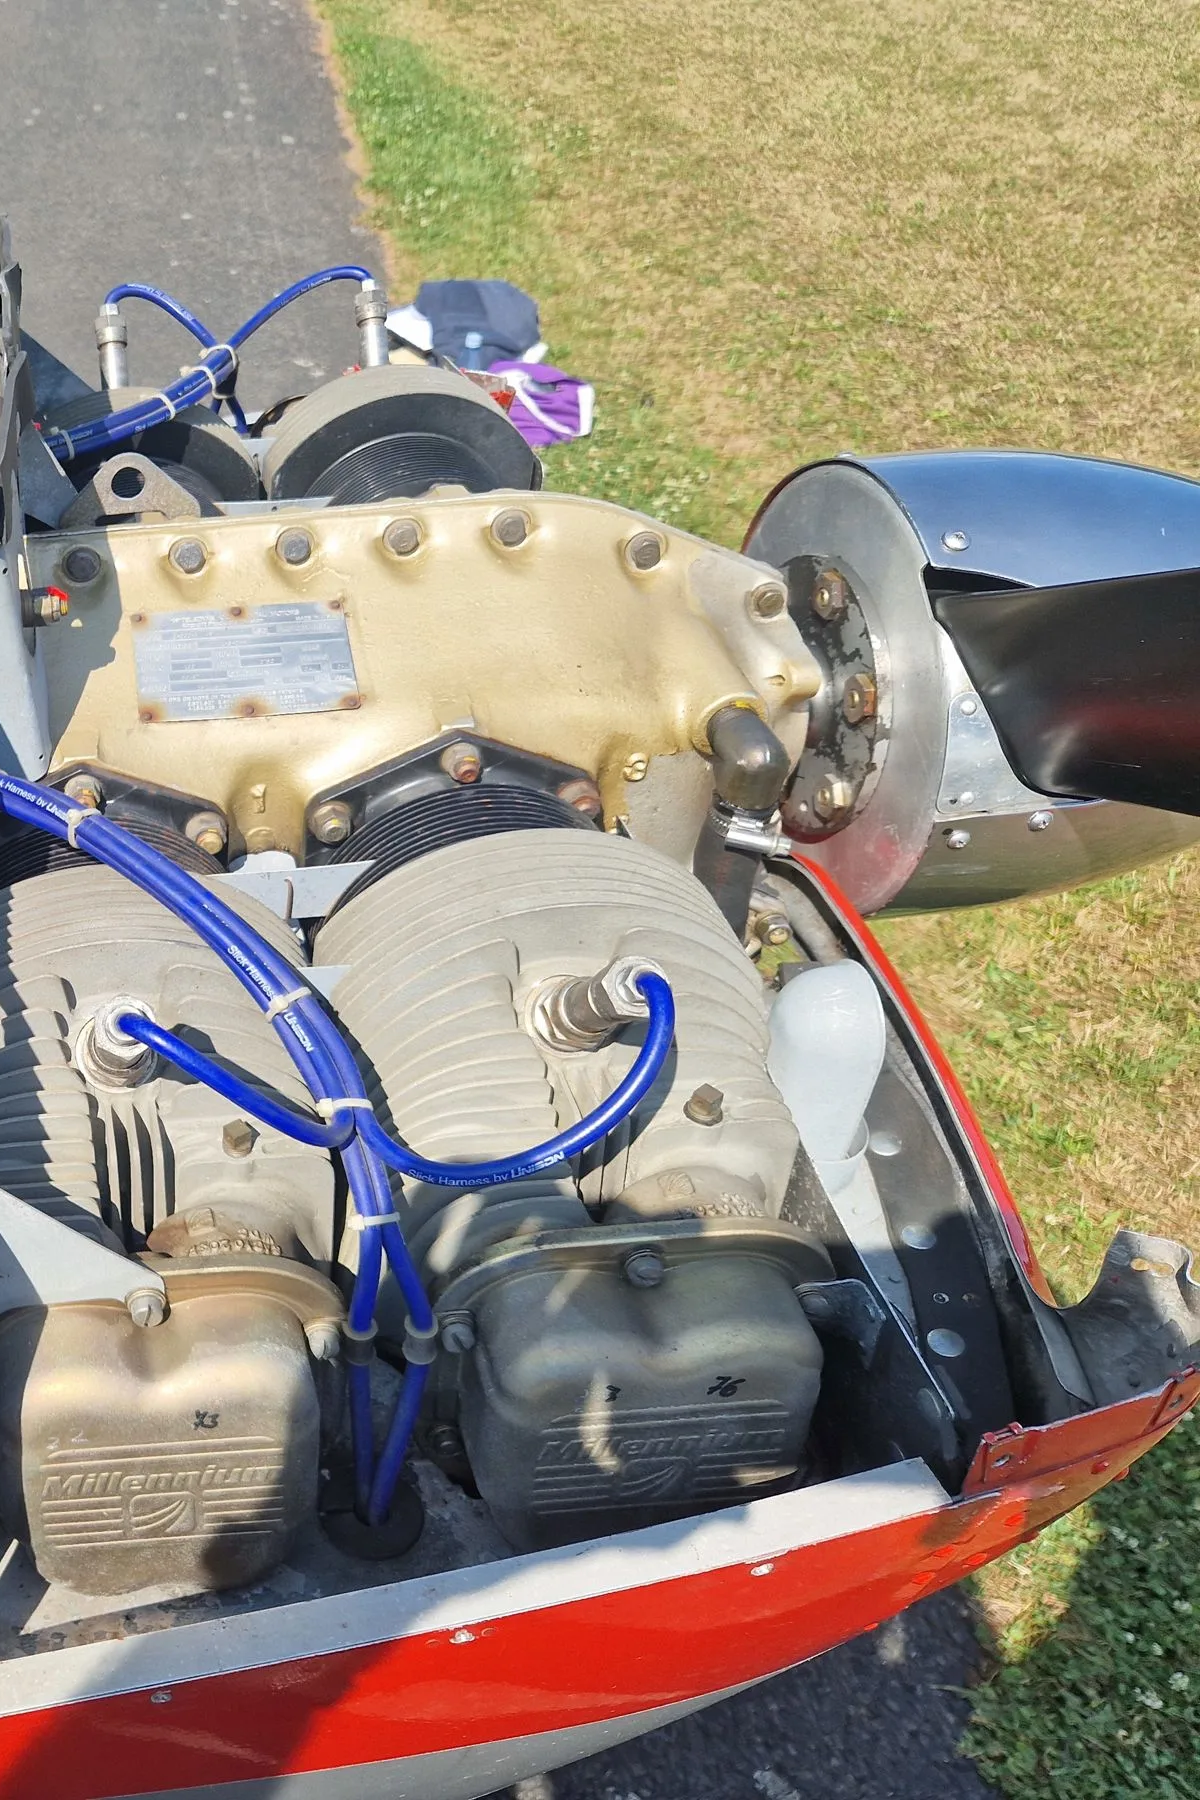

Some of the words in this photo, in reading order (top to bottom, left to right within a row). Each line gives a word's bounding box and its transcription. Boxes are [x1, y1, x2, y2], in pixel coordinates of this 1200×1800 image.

[5, 781, 37, 803] Harness
[35, 797, 48, 808] by
[228, 944, 248, 967] Slick
[408, 1168, 436, 1184] Slick
[438, 1175, 490, 1187] Harness
[493, 1173, 509, 1185] by
[511, 1150, 565, 1179] UNISON
[538, 1429, 785, 1461] Millennium
[42, 1464, 283, 1498] Millennium
